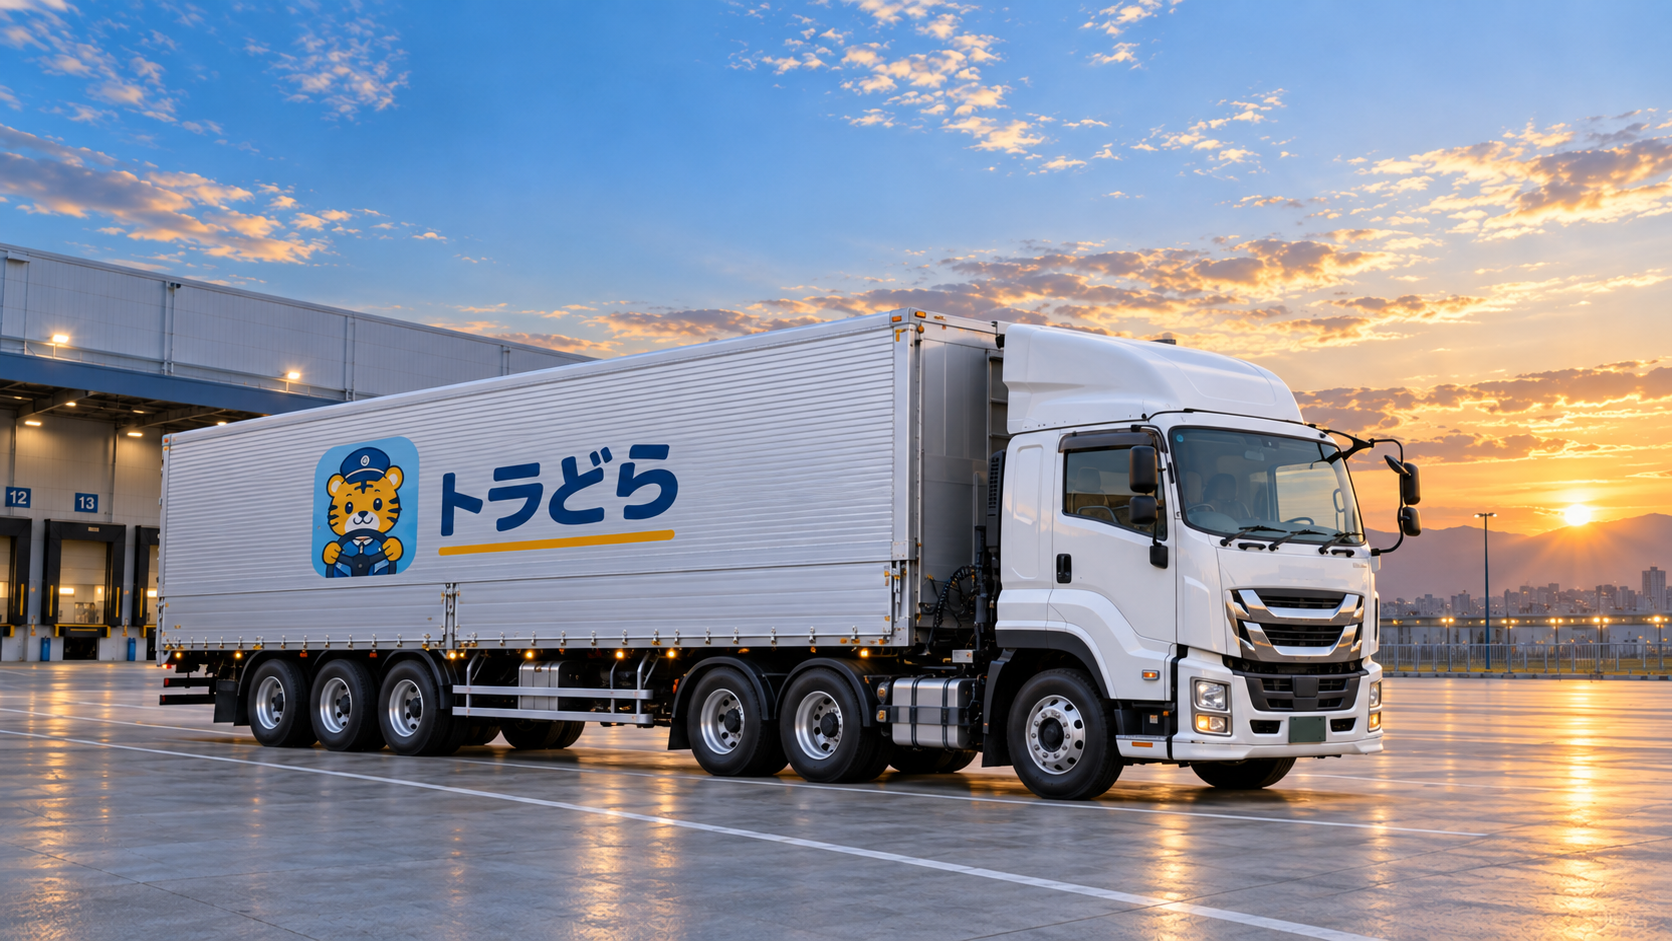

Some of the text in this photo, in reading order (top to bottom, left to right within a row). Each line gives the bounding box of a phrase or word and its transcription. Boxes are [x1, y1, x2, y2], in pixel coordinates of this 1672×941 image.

[10, 490, 27, 504] 12
[441, 444, 679, 537] トラどら
[79, 496, 95, 509] 13
